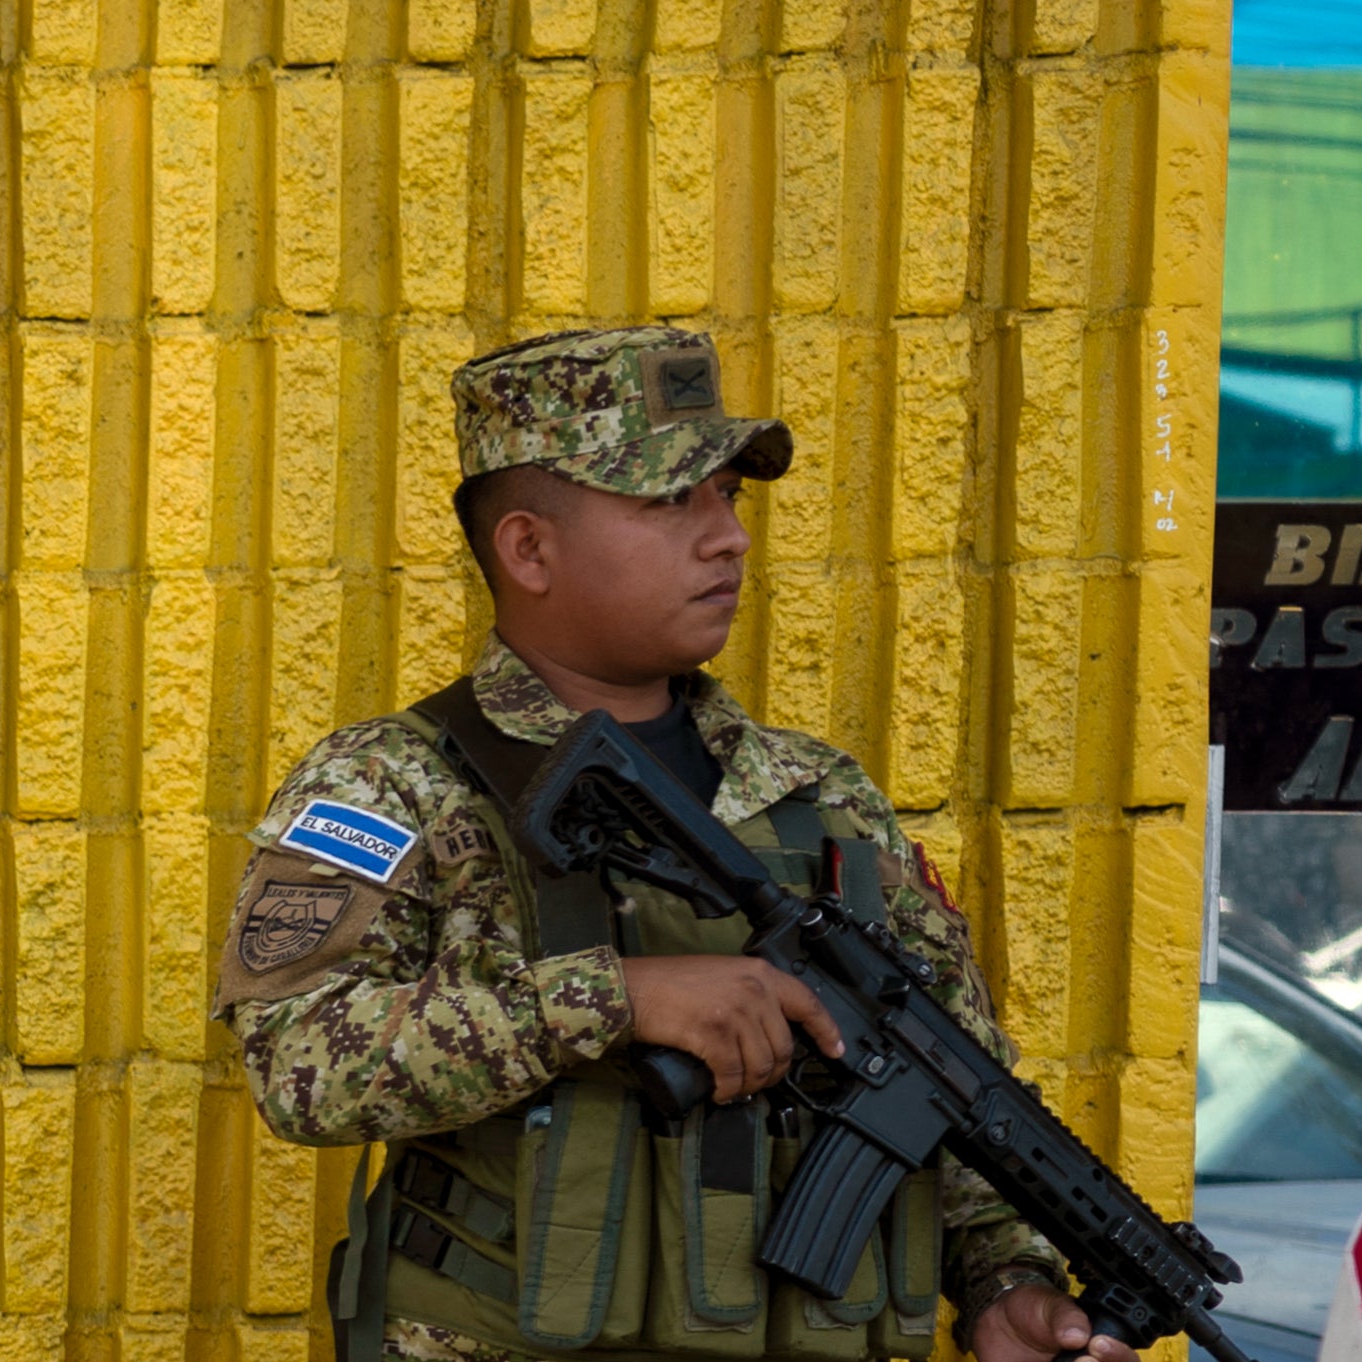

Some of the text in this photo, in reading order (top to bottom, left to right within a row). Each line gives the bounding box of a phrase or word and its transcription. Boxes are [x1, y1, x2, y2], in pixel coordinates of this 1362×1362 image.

[1264, 523, 1362, 586] BI
[301, 816, 397, 860] EL SALVADOR
